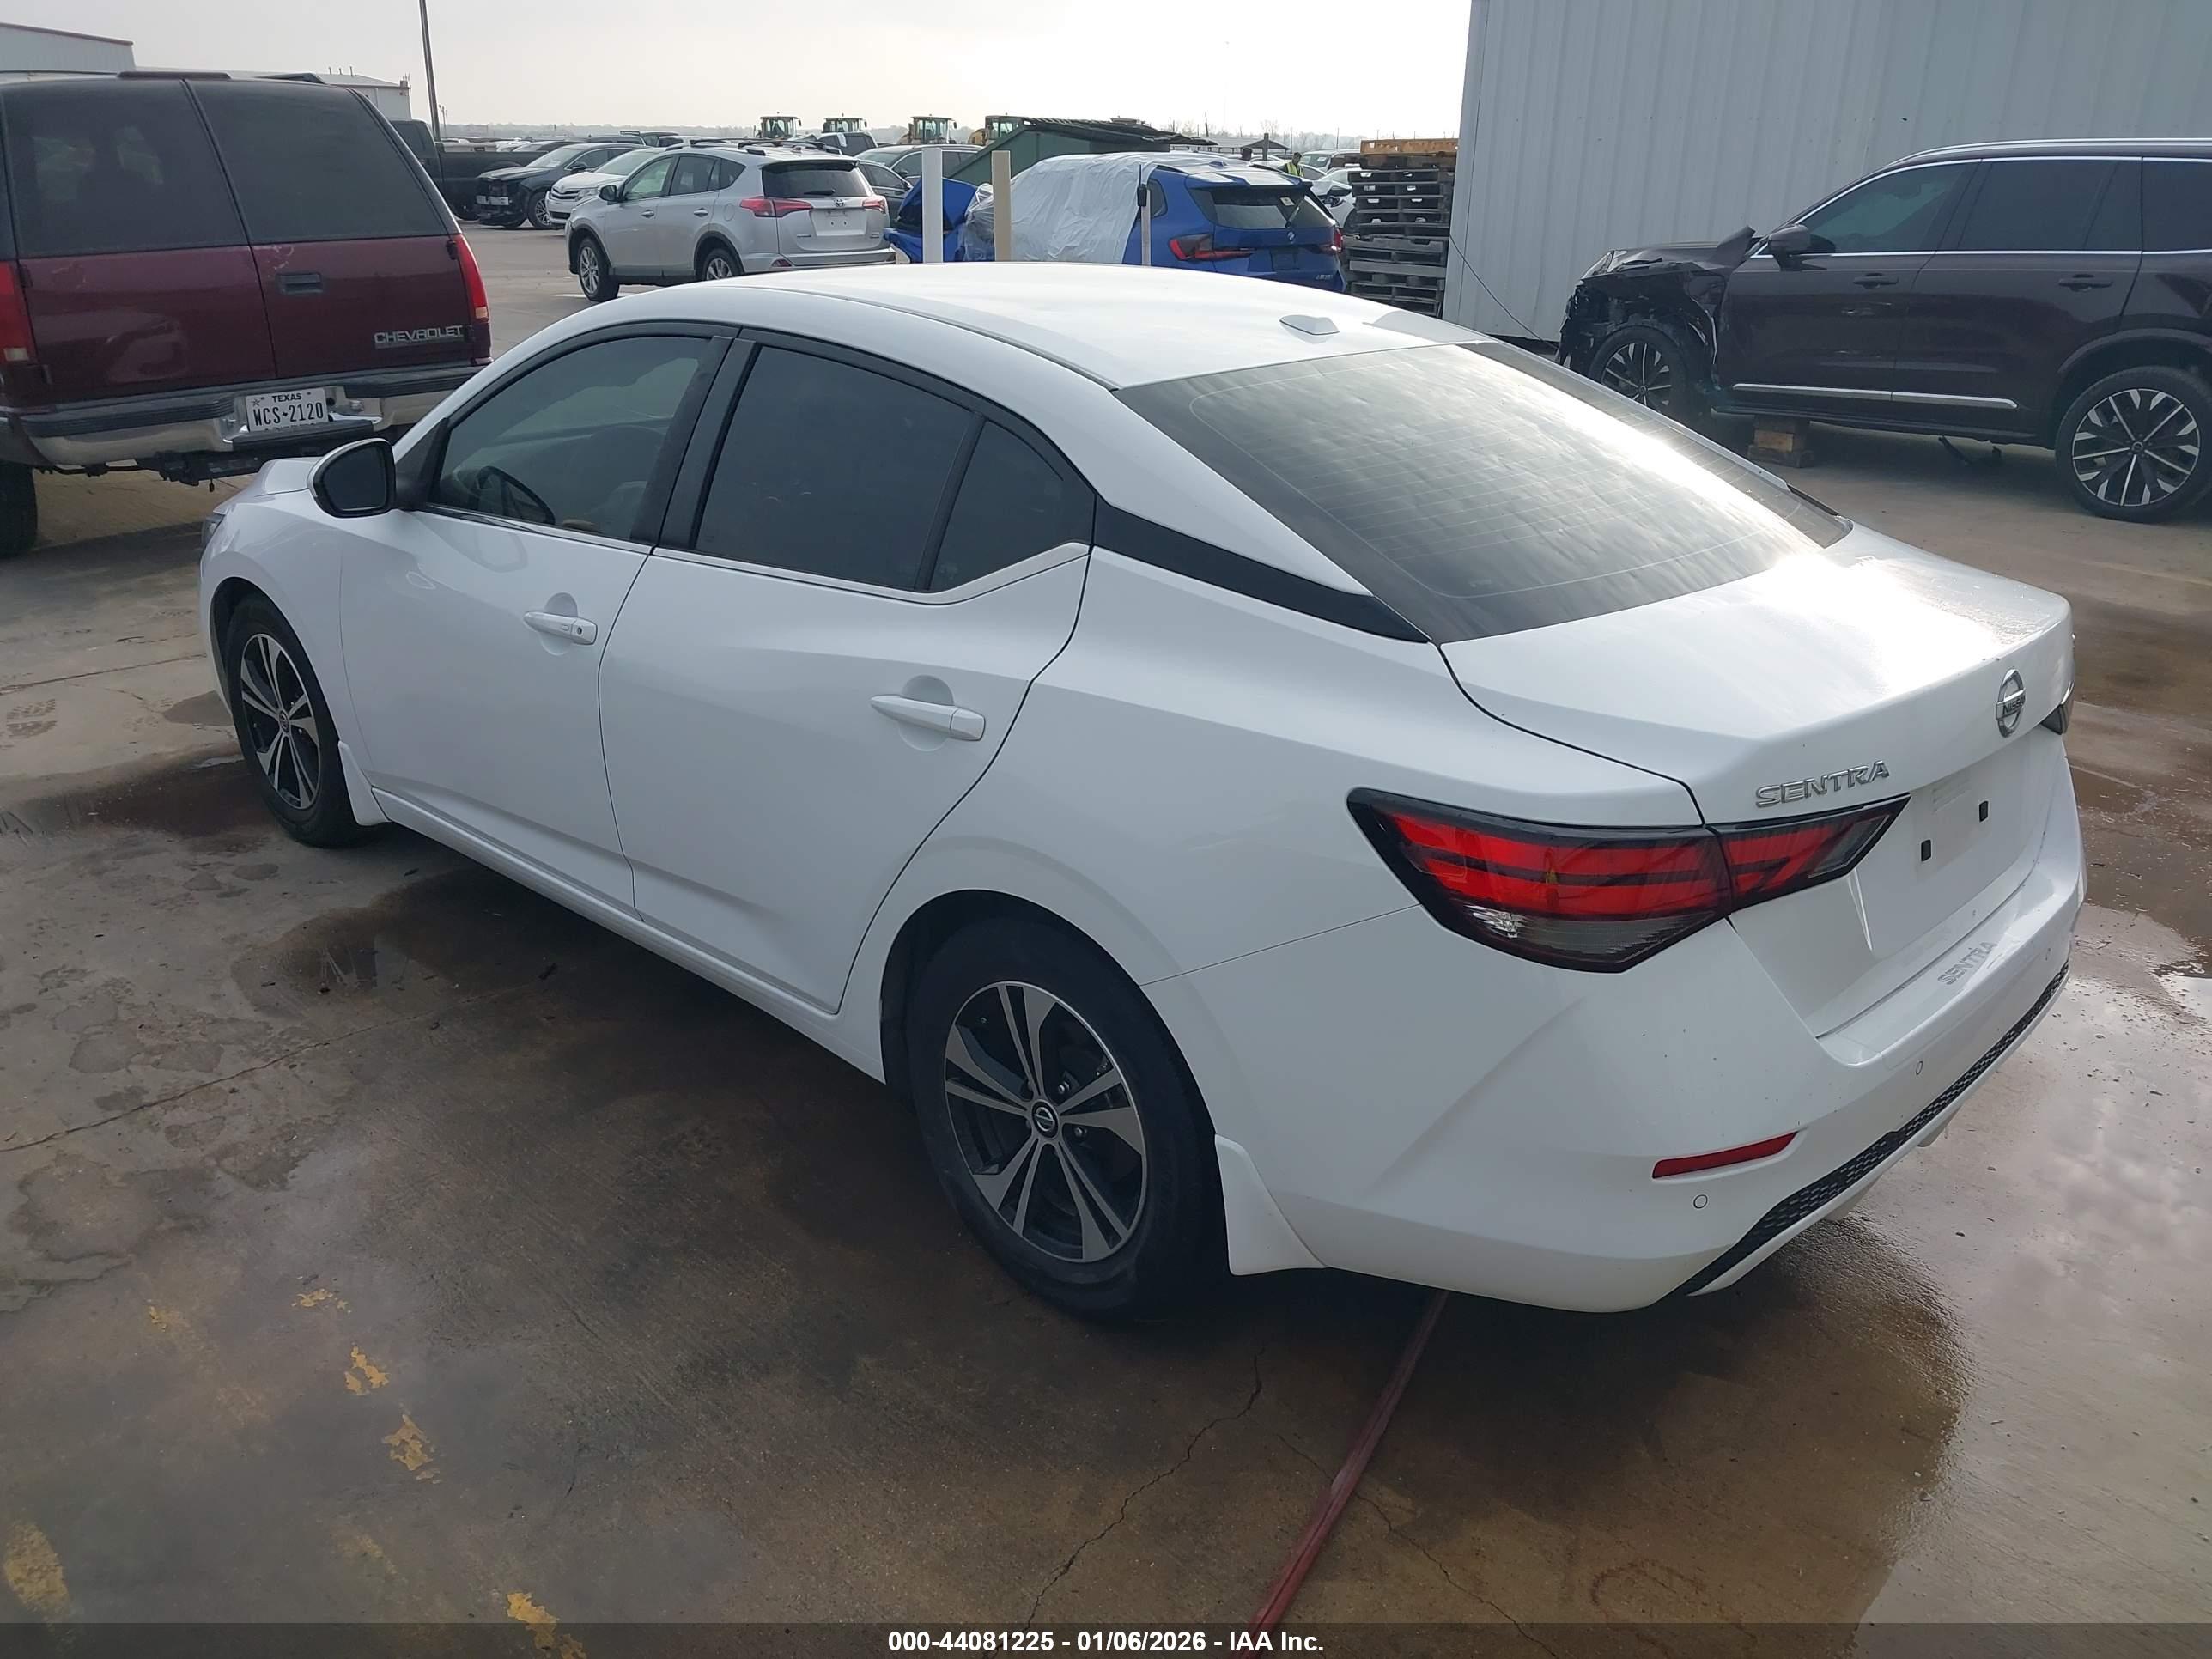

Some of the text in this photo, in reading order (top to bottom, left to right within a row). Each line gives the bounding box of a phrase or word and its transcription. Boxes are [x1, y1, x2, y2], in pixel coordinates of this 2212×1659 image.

[374, 325, 463, 343] CHEVROLET
[272, 393, 302, 403] TEXAS
[1755, 760, 1890, 808] SENTRA
[1937, 941, 1998, 985] SENTRA
